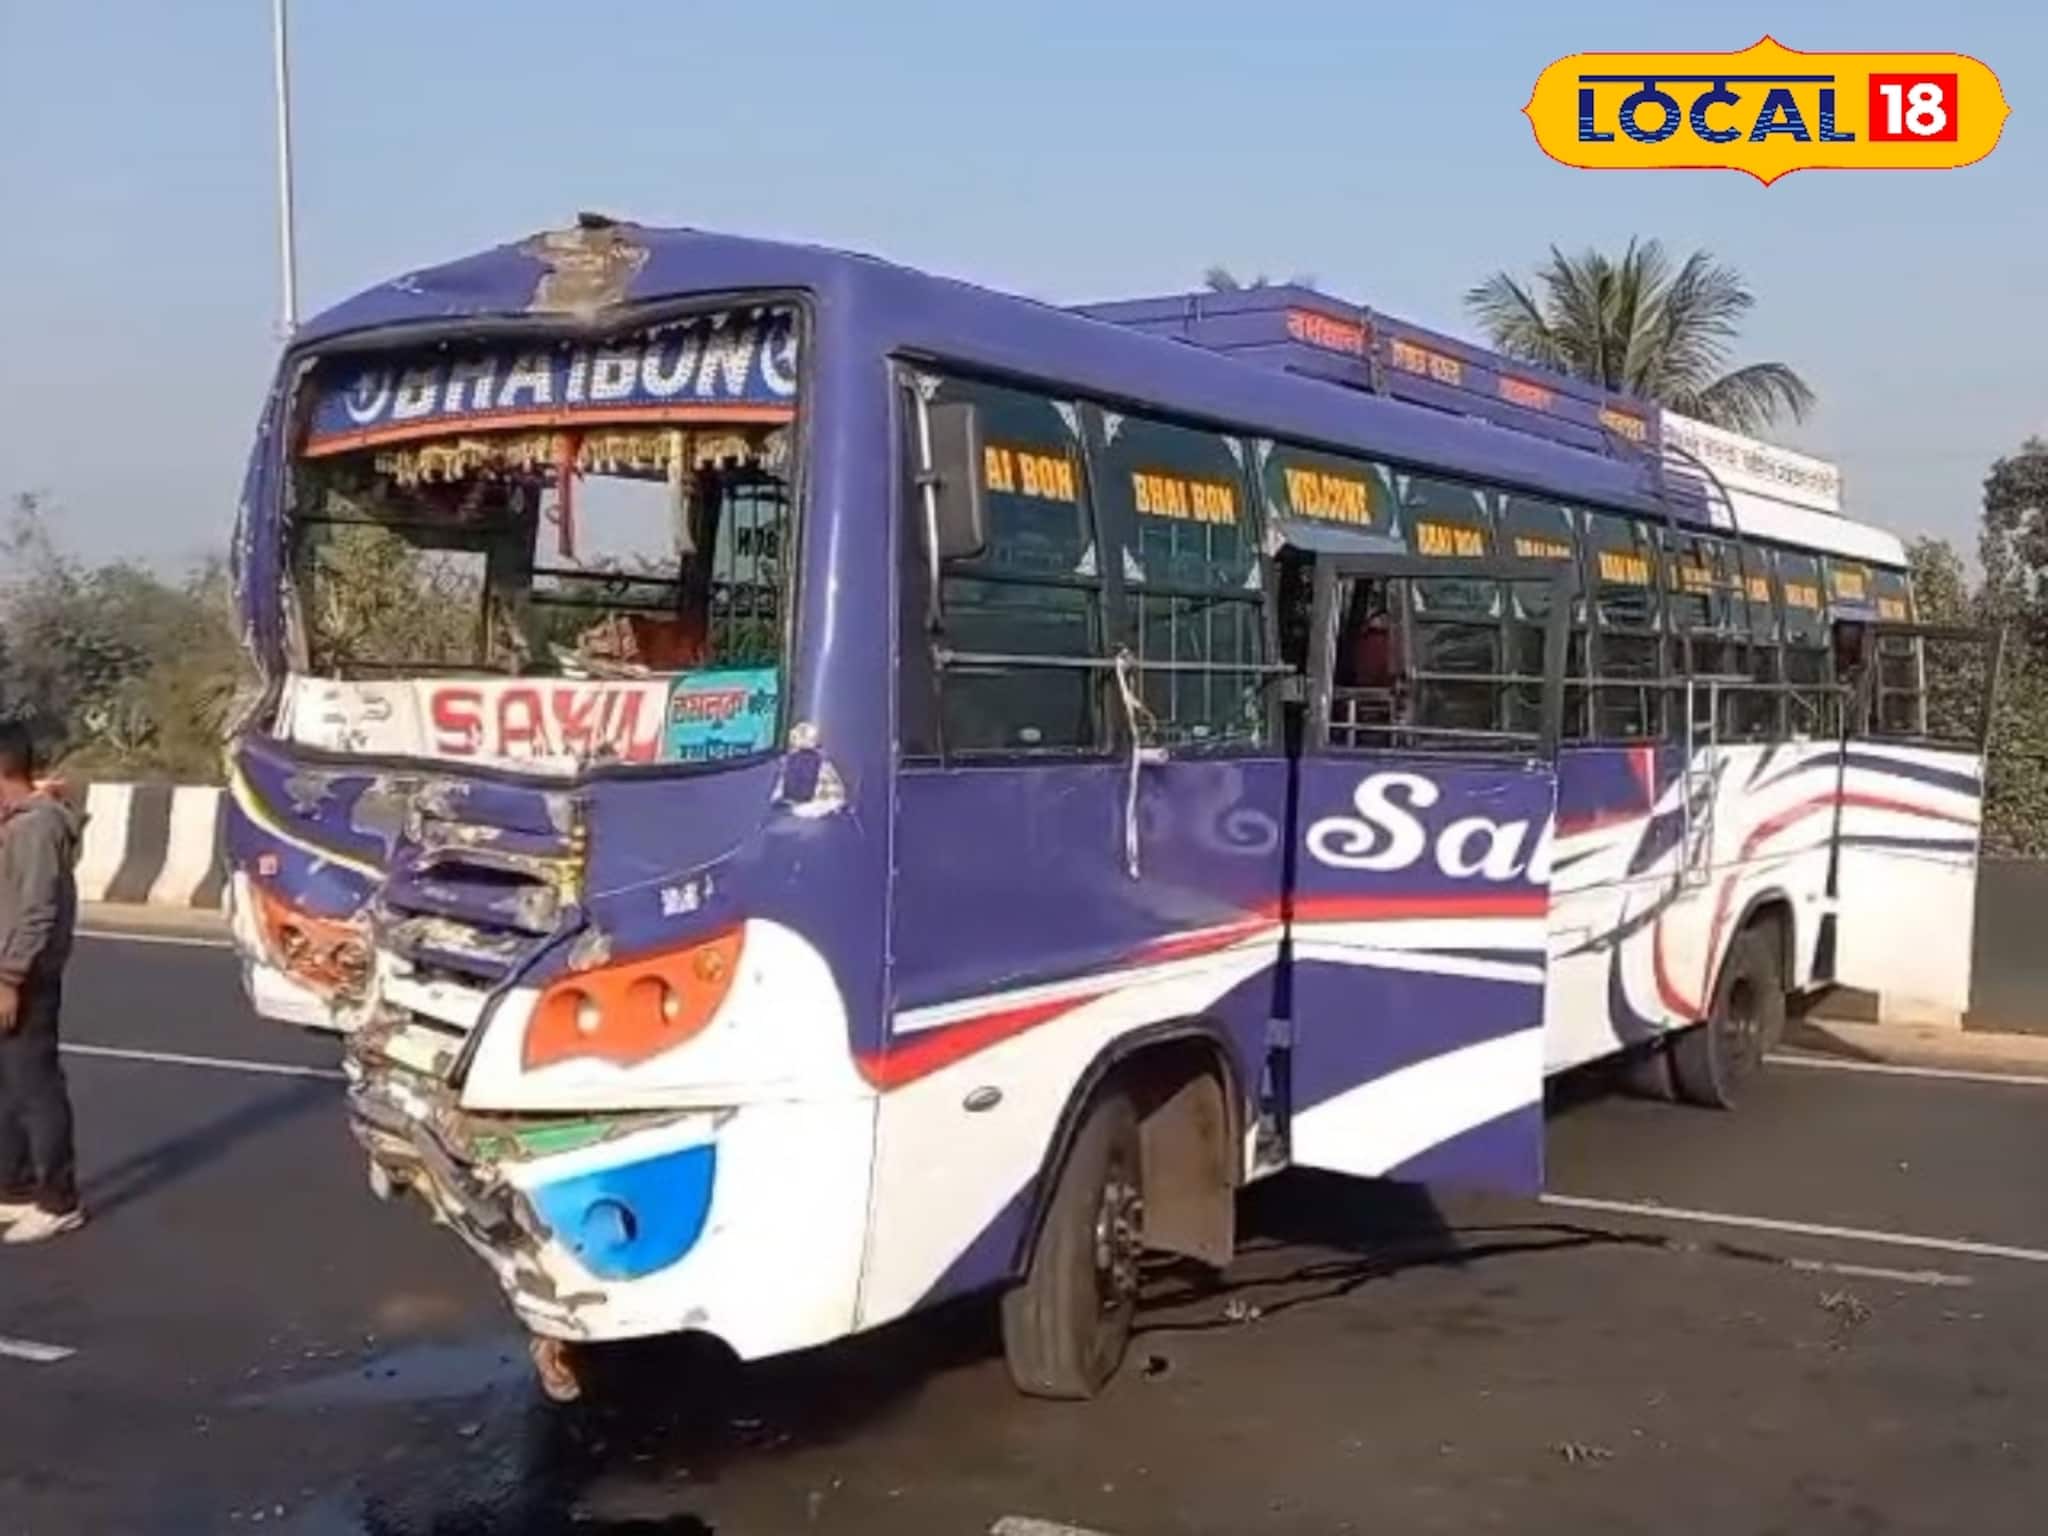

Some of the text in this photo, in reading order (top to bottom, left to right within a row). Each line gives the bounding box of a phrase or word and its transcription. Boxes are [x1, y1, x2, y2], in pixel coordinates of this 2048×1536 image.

[1020, 454, 1075, 502] BON
[1132, 472, 1237, 525] BHAI BON
[1285, 467, 1372, 525] WELCOME
